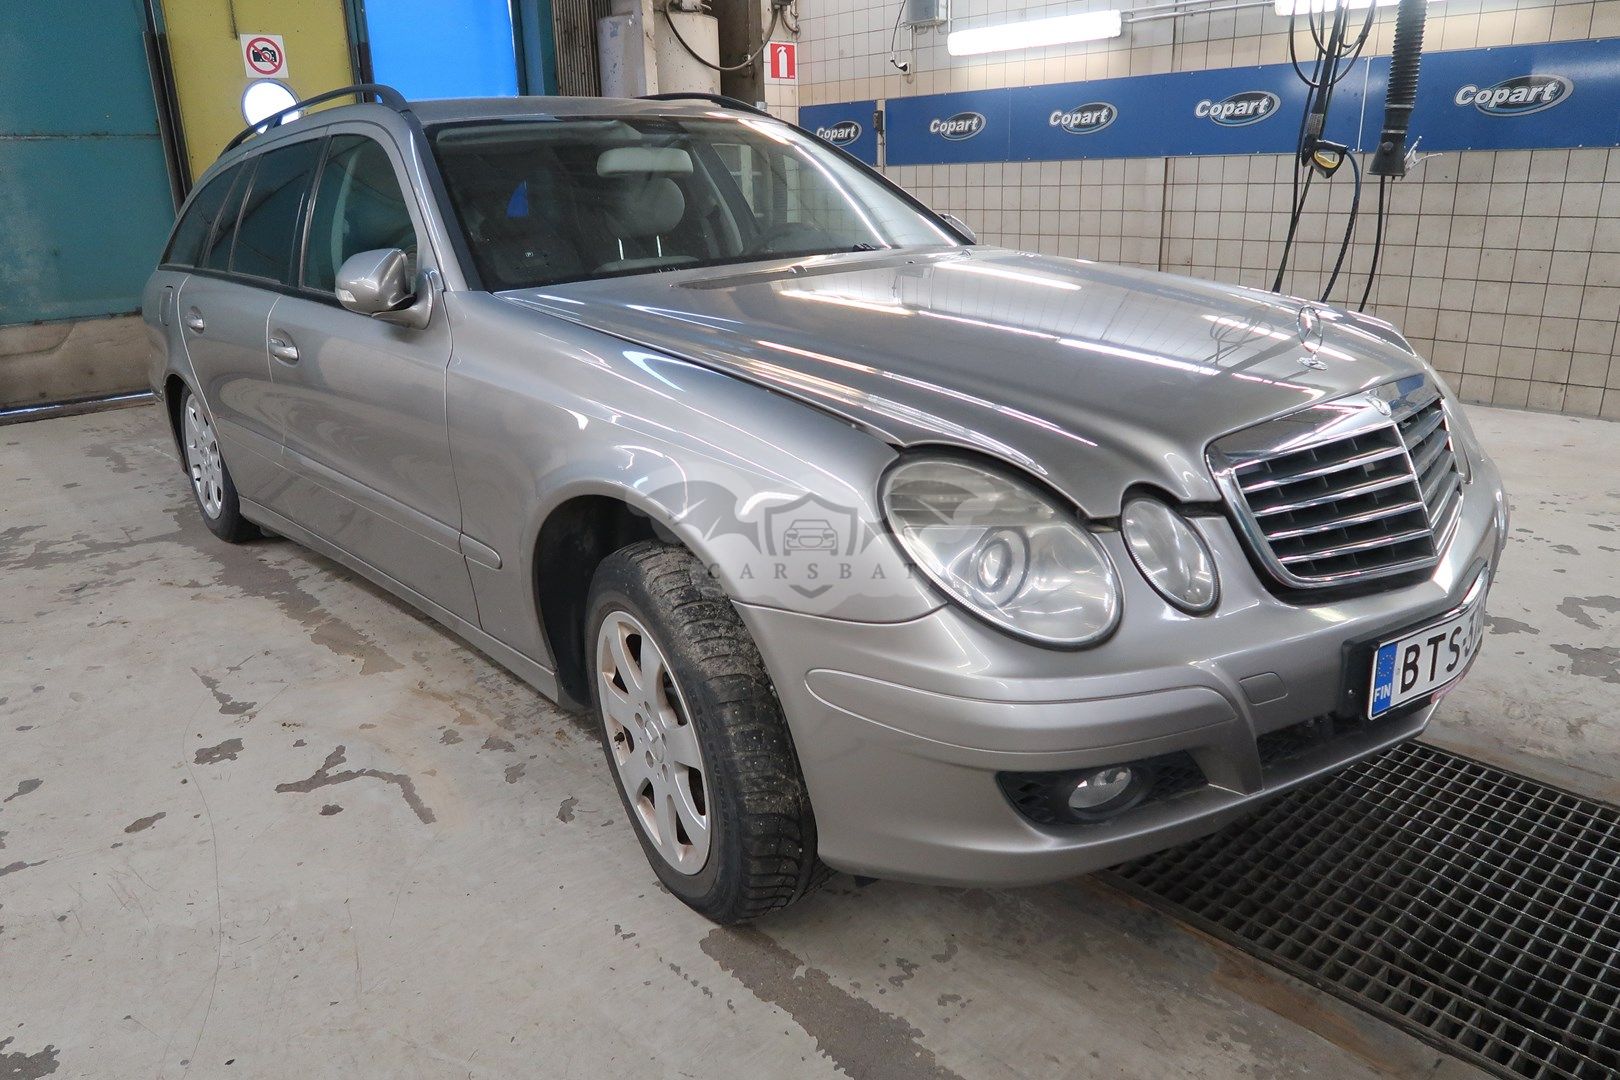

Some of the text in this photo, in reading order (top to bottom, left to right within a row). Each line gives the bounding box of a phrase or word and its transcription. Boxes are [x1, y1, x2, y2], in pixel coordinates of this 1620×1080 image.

[1455, 82, 1558, 108] Copart
[1050, 106, 1109, 128] Copart
[1195, 96, 1269, 119] Copart
[816, 125, 857, 142] Copart
[930, 117, 980, 135] Copart
[1374, 682, 1391, 703] FIN
